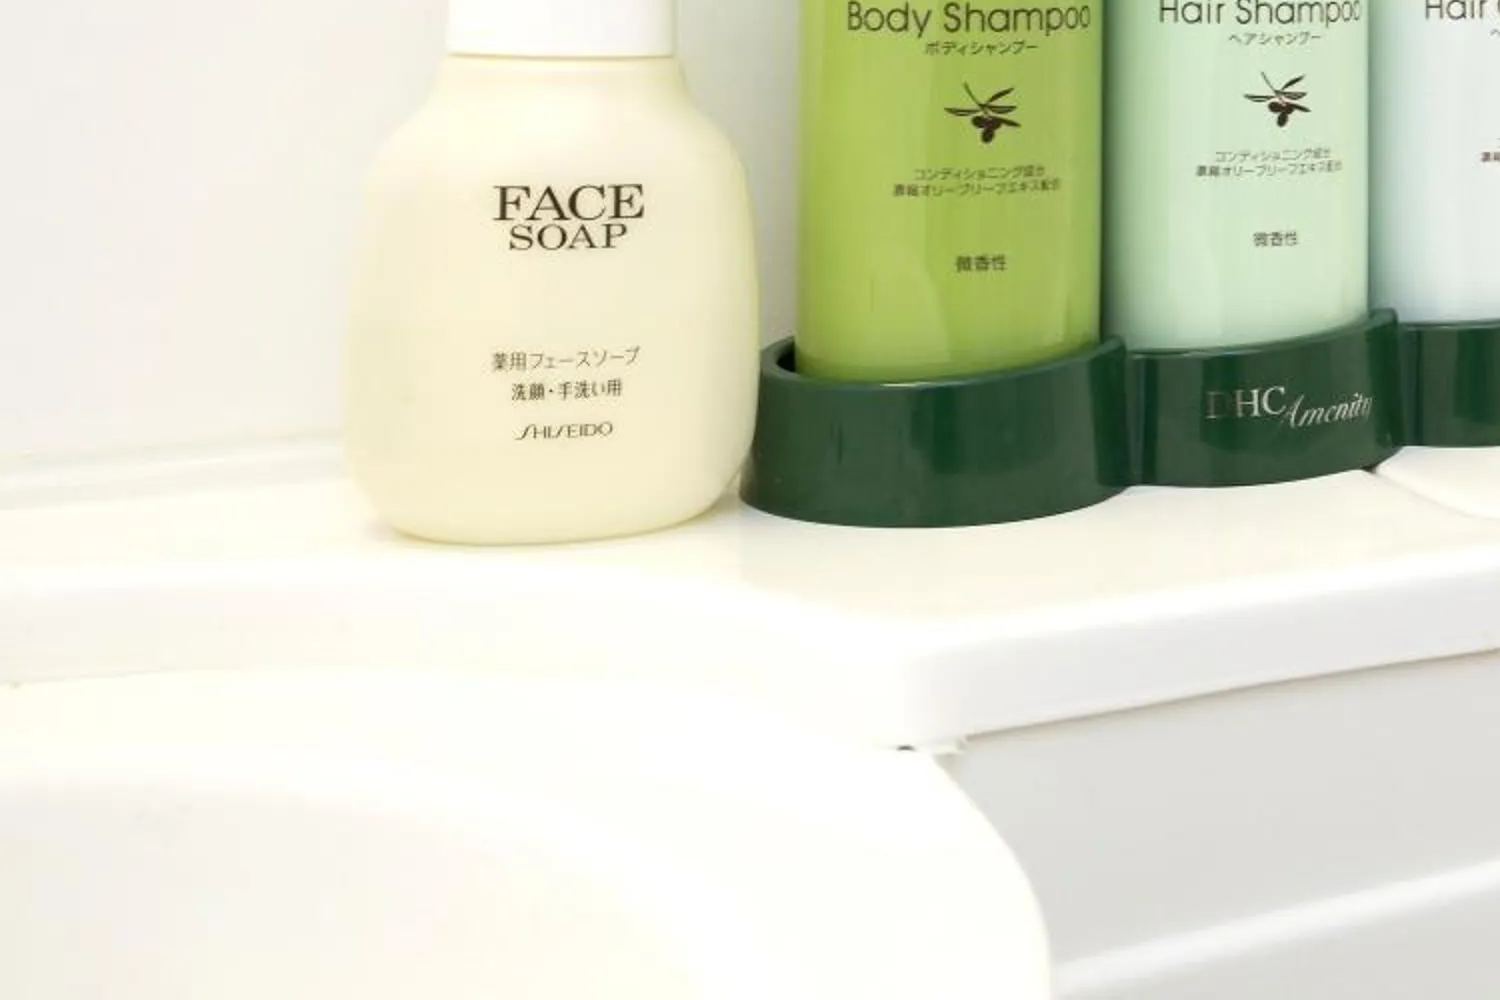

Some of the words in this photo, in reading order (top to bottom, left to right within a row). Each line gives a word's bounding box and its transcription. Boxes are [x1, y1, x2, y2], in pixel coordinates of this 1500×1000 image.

[847, 1, 932, 38] Body
[943, 2, 1091, 36] Shampoo
[924, 40, 1038, 56] ボディシャンプー
[1228, 31, 1322, 46] ヘアシャンプー
[492, 184, 645, 221] FACE
[508, 223, 628, 250] SOAP
[1253, 231, 1299, 247] 微香性
[956, 255, 1007, 272] 微香性
[492, 346, 641, 372] 薬用フェースソープ
[511, 378, 624, 401] 洗顔・手洗い用
[1282, 392, 1373, 429] Amenity
[515, 421, 613, 440] SHISEIDO
